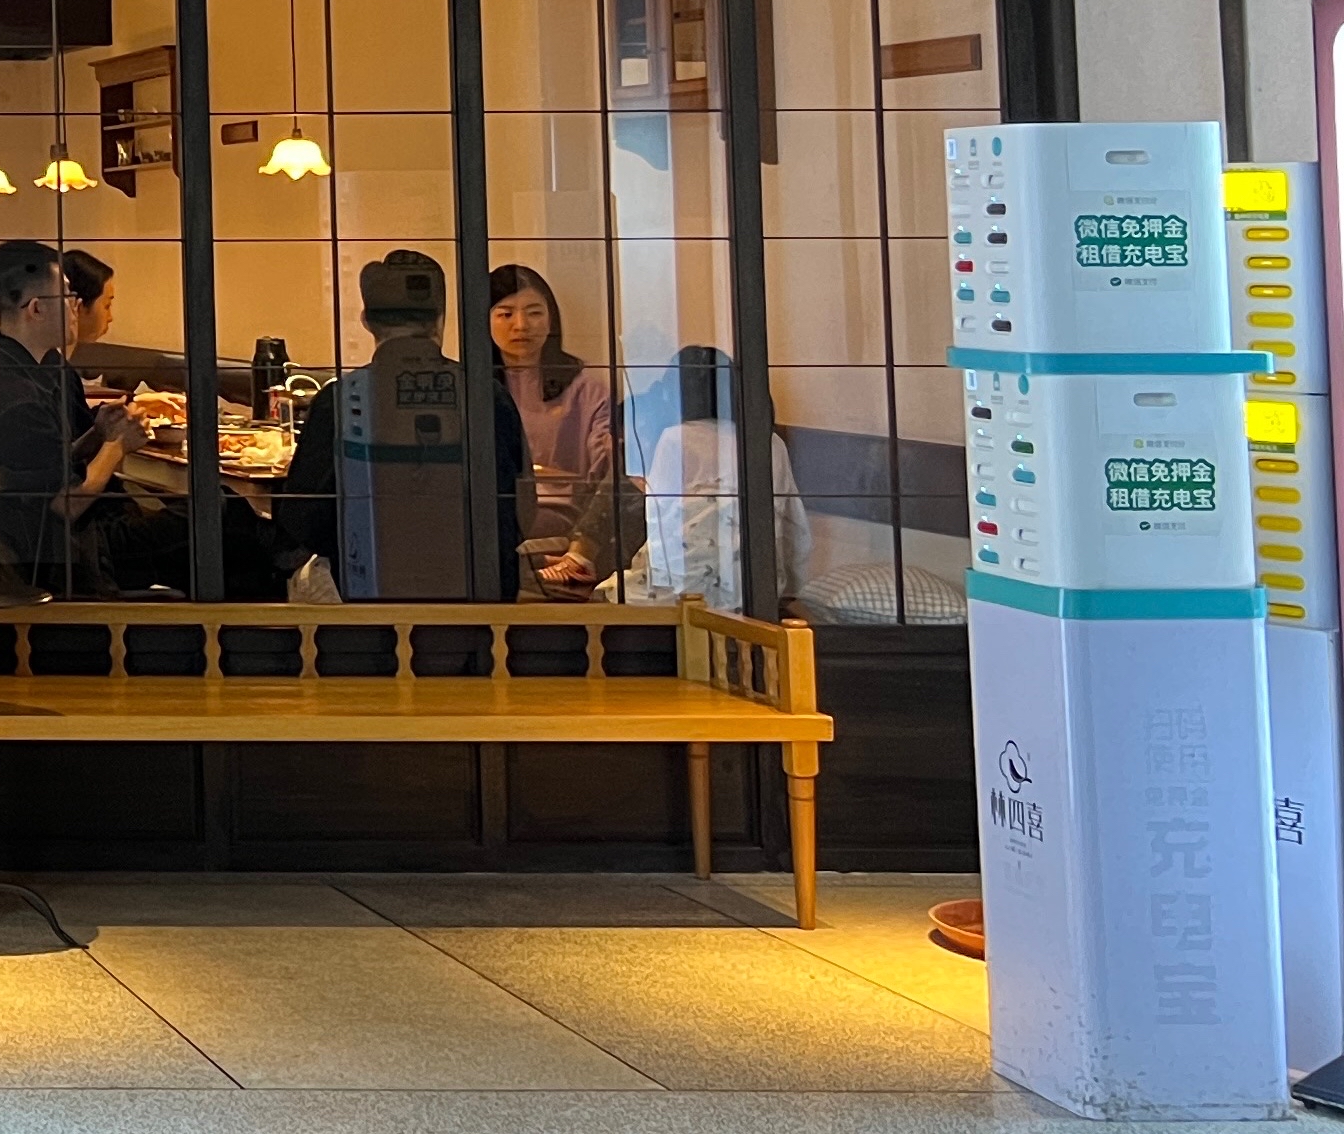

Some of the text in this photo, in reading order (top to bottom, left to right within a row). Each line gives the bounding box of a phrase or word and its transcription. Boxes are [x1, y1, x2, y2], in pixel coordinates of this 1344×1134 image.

[1077, 218, 1185, 239] 微信免押金
[1077, 244, 1186, 264] 租借充电宝
[1107, 462, 1212, 482] 微信免押金
[1108, 487, 1213, 509] 租借充电宝
[990, 787, 1044, 842] 林四喜
